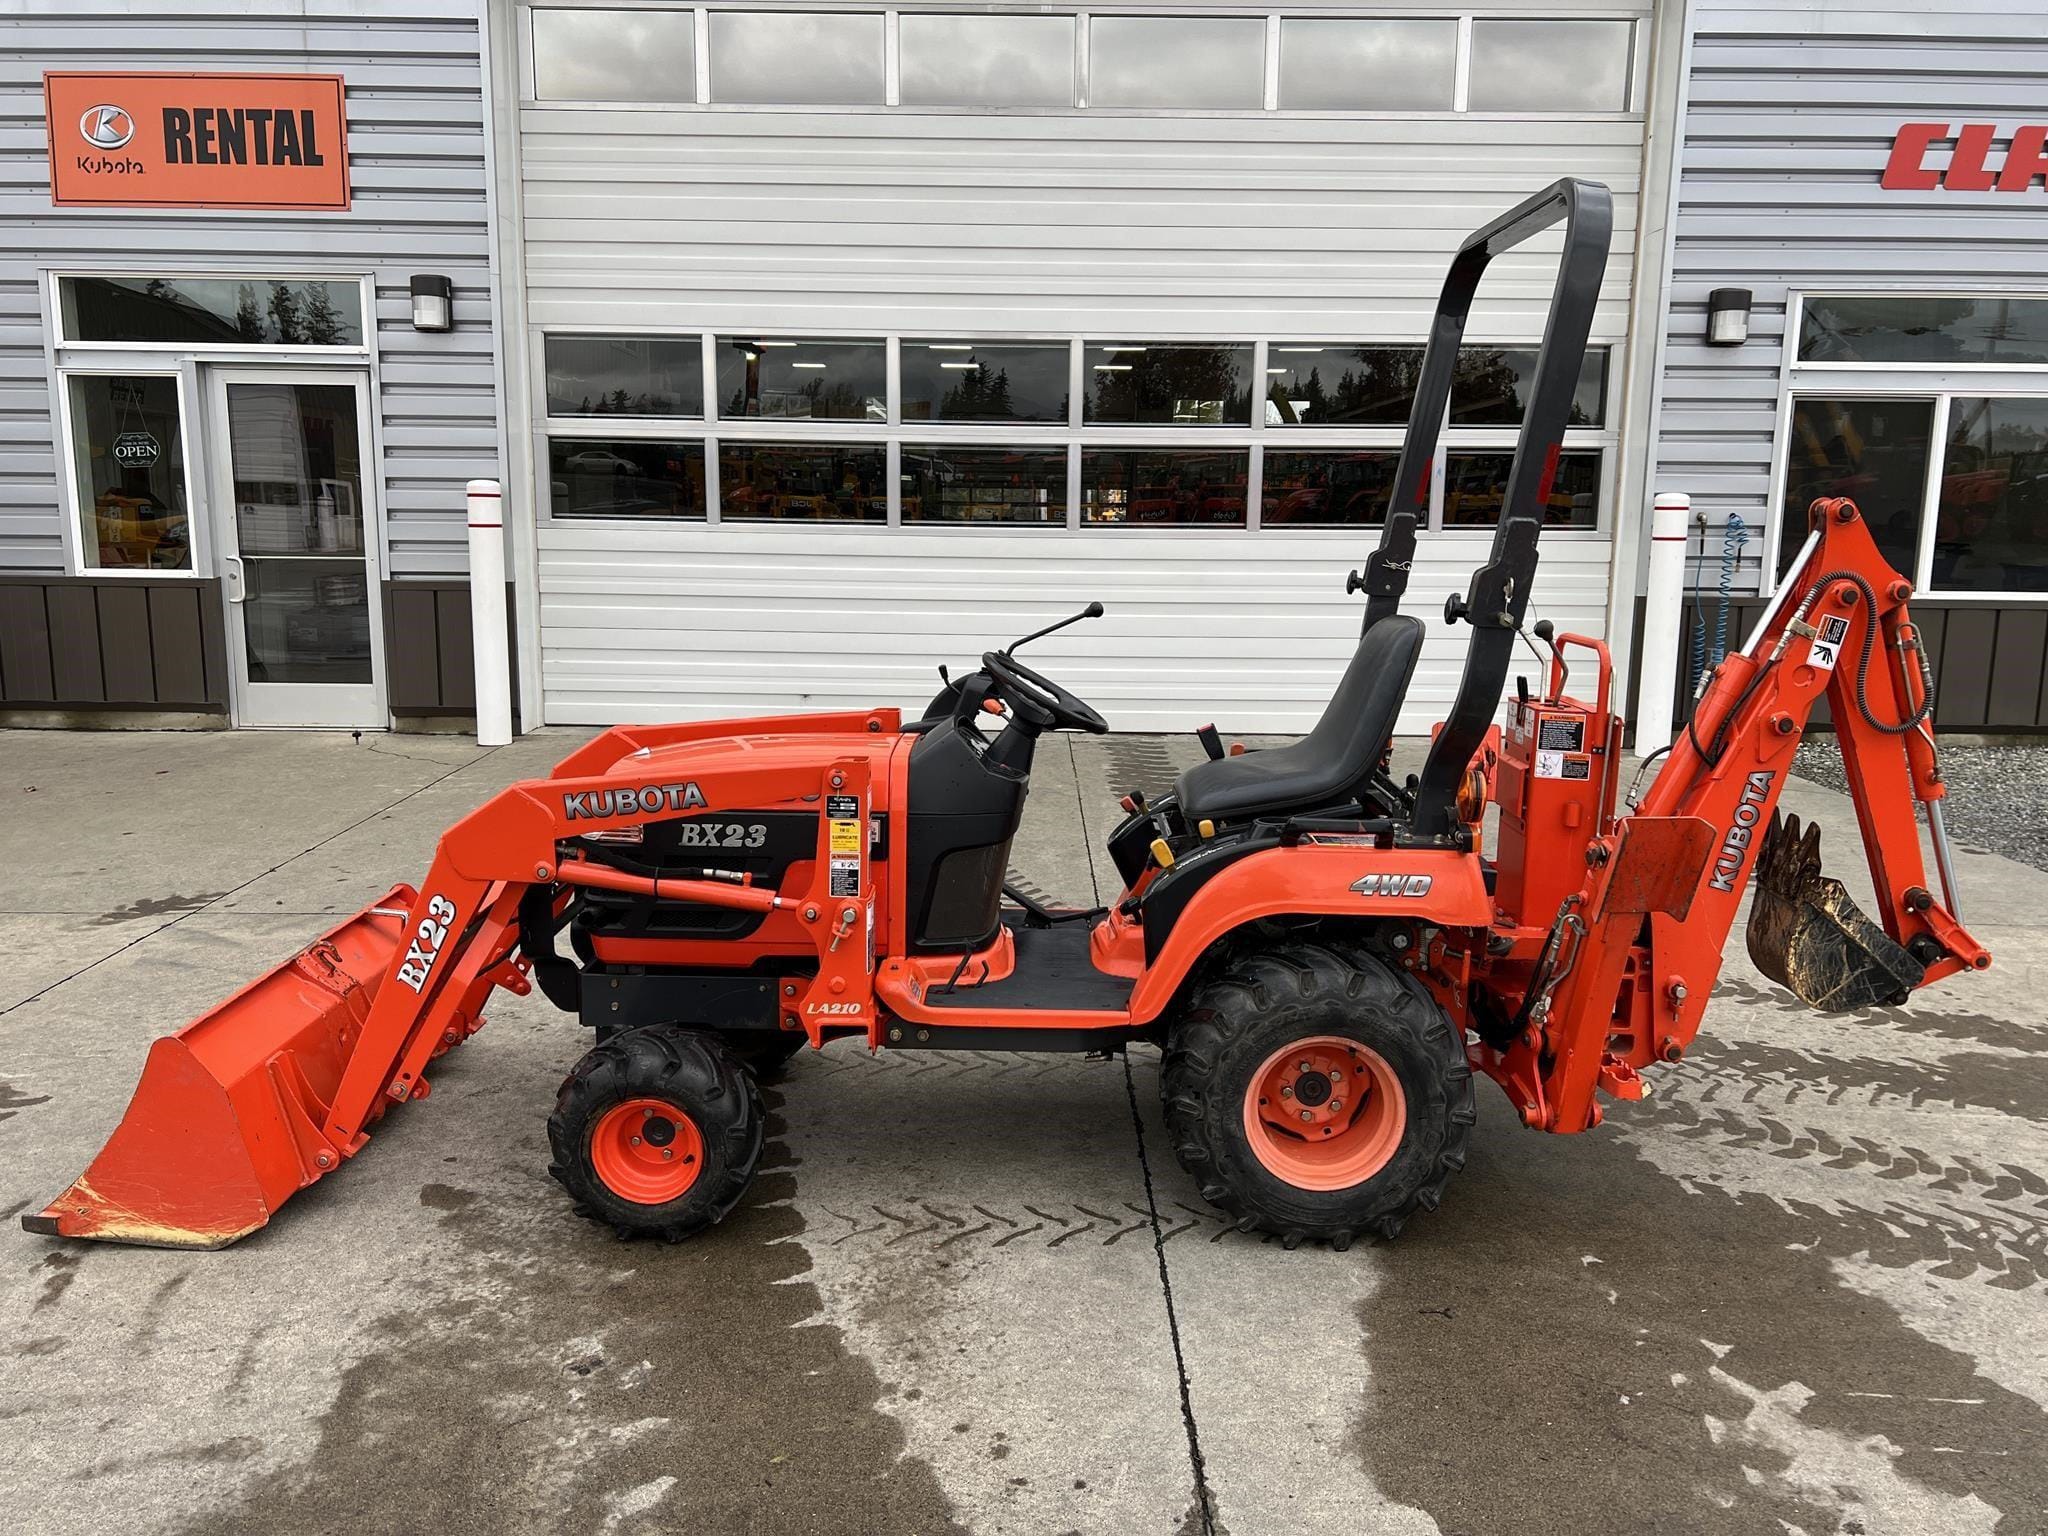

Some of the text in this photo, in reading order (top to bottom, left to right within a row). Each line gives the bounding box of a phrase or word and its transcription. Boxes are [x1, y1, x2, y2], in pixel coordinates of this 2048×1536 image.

[162, 107, 324, 167] RENTAL
[77, 156, 145, 174] Kubota
[115, 445, 158, 458] OPEN
[563, 782, 708, 820] KUBOTA
[678, 823, 768, 848] BX23
[1709, 770, 1776, 892] KUBOTA
[1349, 874, 1433, 897] 4WD
[396, 893, 457, 994] BX23
[806, 1003, 861, 1015] LA210
